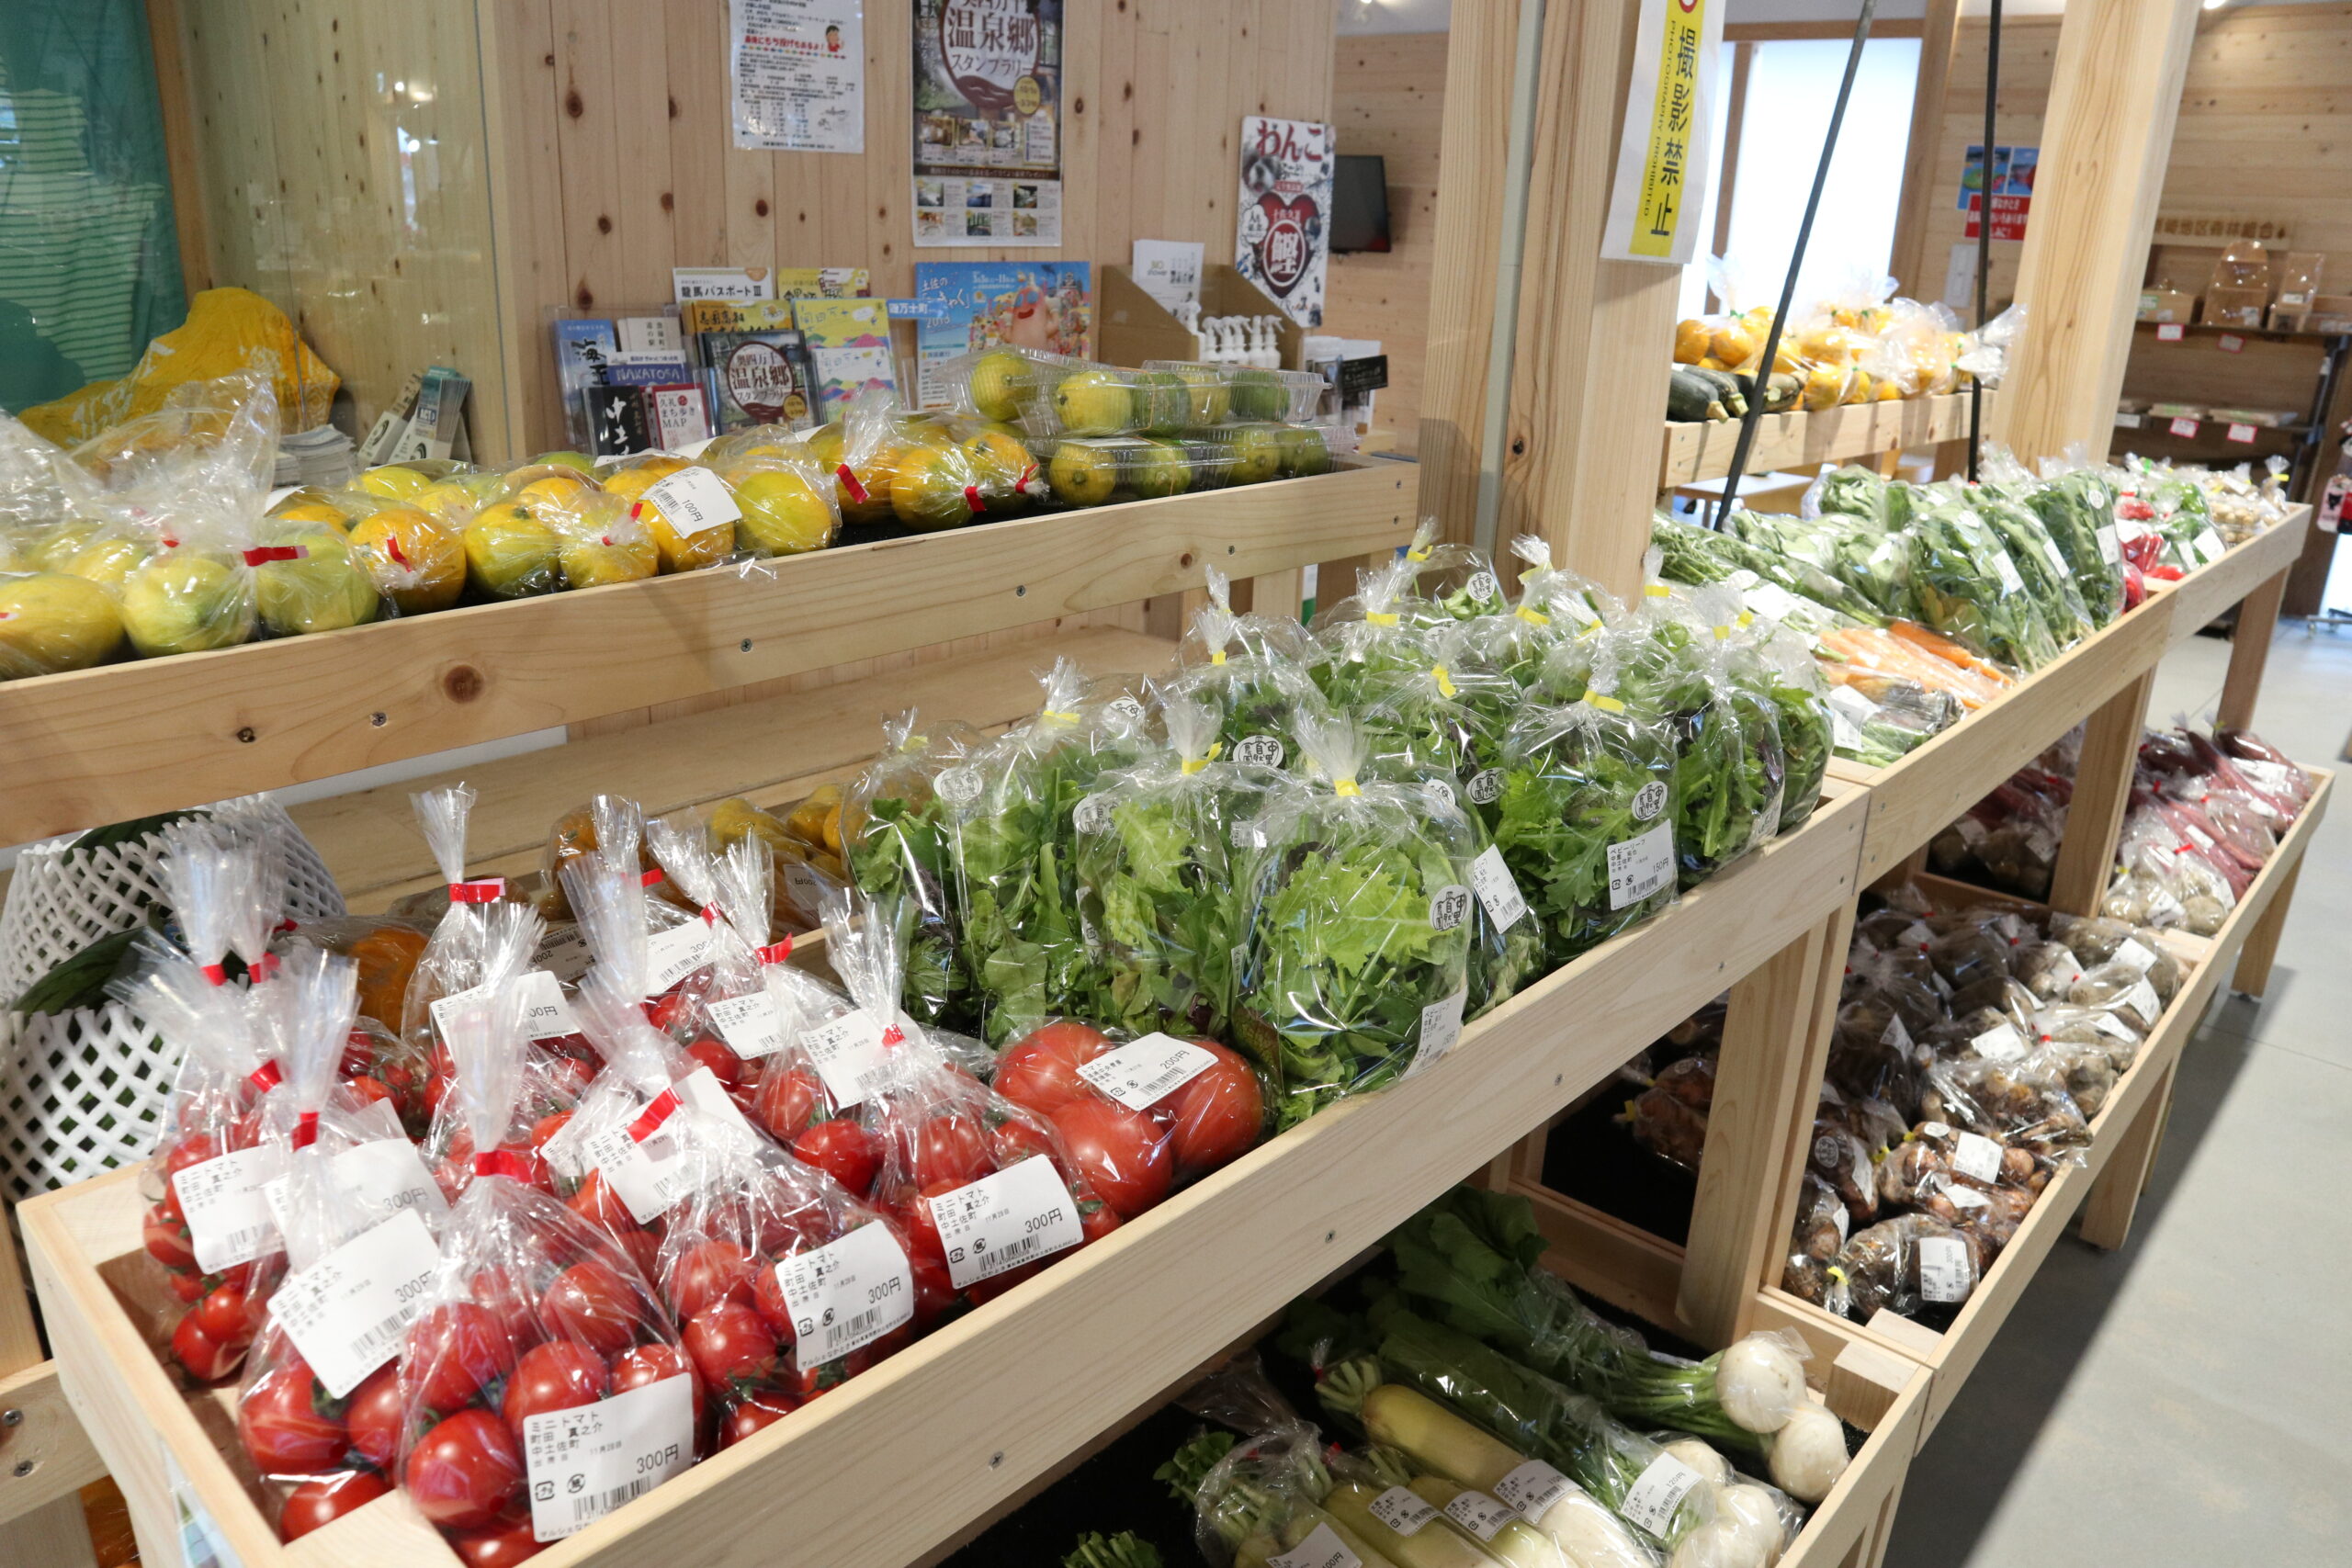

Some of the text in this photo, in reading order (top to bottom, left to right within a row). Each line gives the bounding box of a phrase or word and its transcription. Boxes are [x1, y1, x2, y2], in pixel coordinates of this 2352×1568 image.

[947, 8, 1035, 55] 温泉郷
[950, 53, 1033, 76] スタンプラリー
[1643, 20, 1677, 217] PHOTOGRAPHY PROHIBITED
[1257, 119, 1322, 162] わんこ
[1650, 26, 1696, 236] 撮影禁止
[616, 367, 680, 381] NAKATOSA
[731, 365, 789, 389] 温泉郷
[660, 398, 677, 408] 久礼
[662, 407, 695, 418] まち歩き
[662, 418, 687, 428] MAP
[682, 499, 704, 523] 100円
[1610, 839, 1646, 855] ベビーリーフ
[1654, 857, 1669, 874] 150円
[713, 998, 754, 1012] ミニトマト
[803, 1025, 842, 1045] ミニトマト
[1159, 1049, 1190, 1070] 200円
[590, 1118, 636, 1151] ミニトマ
[179, 1160, 238, 1184] ミニトマト
[382, 1187, 428, 1212] 300円
[935, 1188, 985, 1212] ミニトマト
[937, 1195, 990, 1222] 町田 真之介
[940, 1211, 978, 1229] 中土佐町
[1024, 1207, 1063, 1234] 300円
[784, 1250, 834, 1277] ミニトマト
[785, 1259, 840, 1287] 町田 真之介
[277, 1264, 334, 1309] ミニトマト
[788, 1278, 826, 1297] 中土佐町
[867, 1276, 901, 1304] 300円
[531, 1410, 599, 1432] ミニトマト
[530, 1422, 603, 1445] 町田 真之介
[531, 1439, 580, 1456] 中土佐町
[636, 1444, 679, 1474] 300円
[1666, 1472, 1686, 1488] 120円
